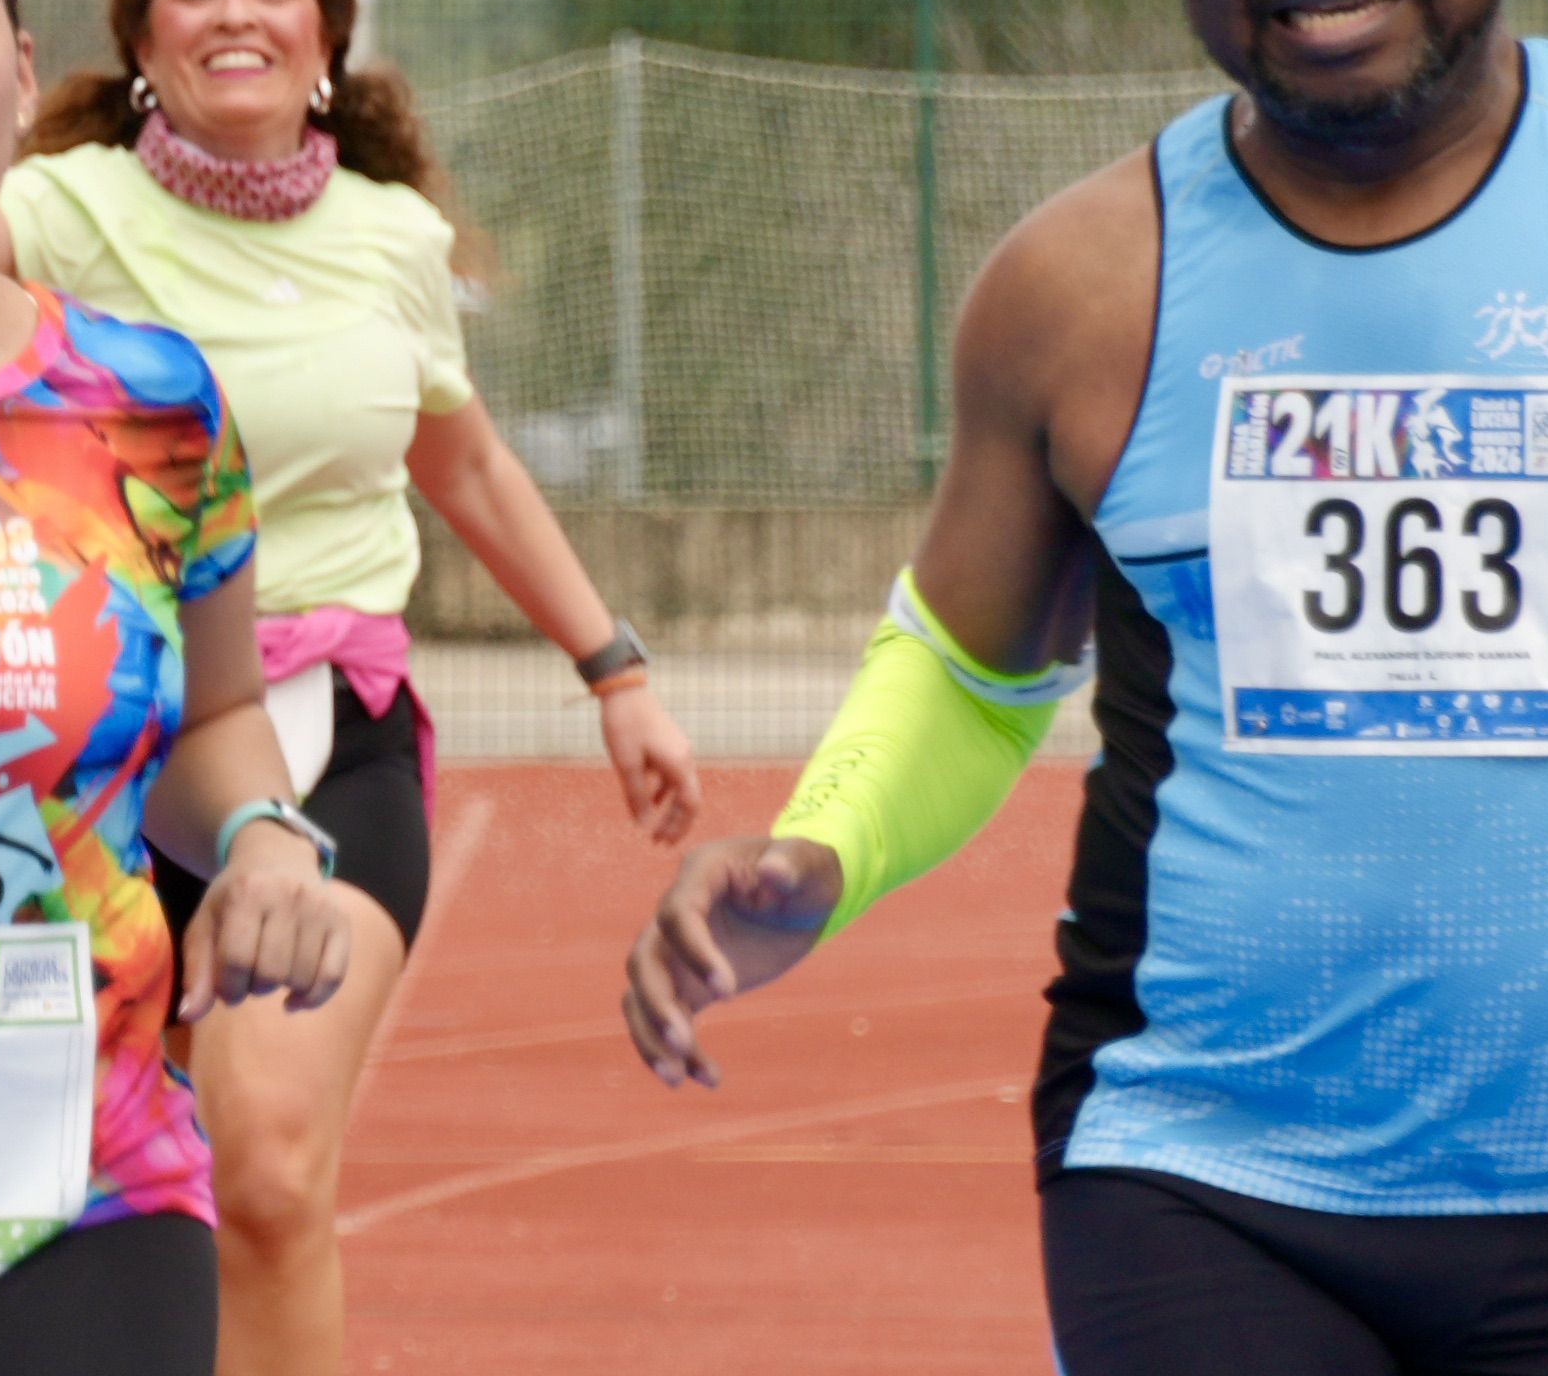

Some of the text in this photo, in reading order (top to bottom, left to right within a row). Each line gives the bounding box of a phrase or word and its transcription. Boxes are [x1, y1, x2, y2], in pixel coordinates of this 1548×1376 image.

[1271, 391, 1400, 477] 21K
[1470, 446, 1522, 473] 2026
[1302, 497, 1523, 634] 363
